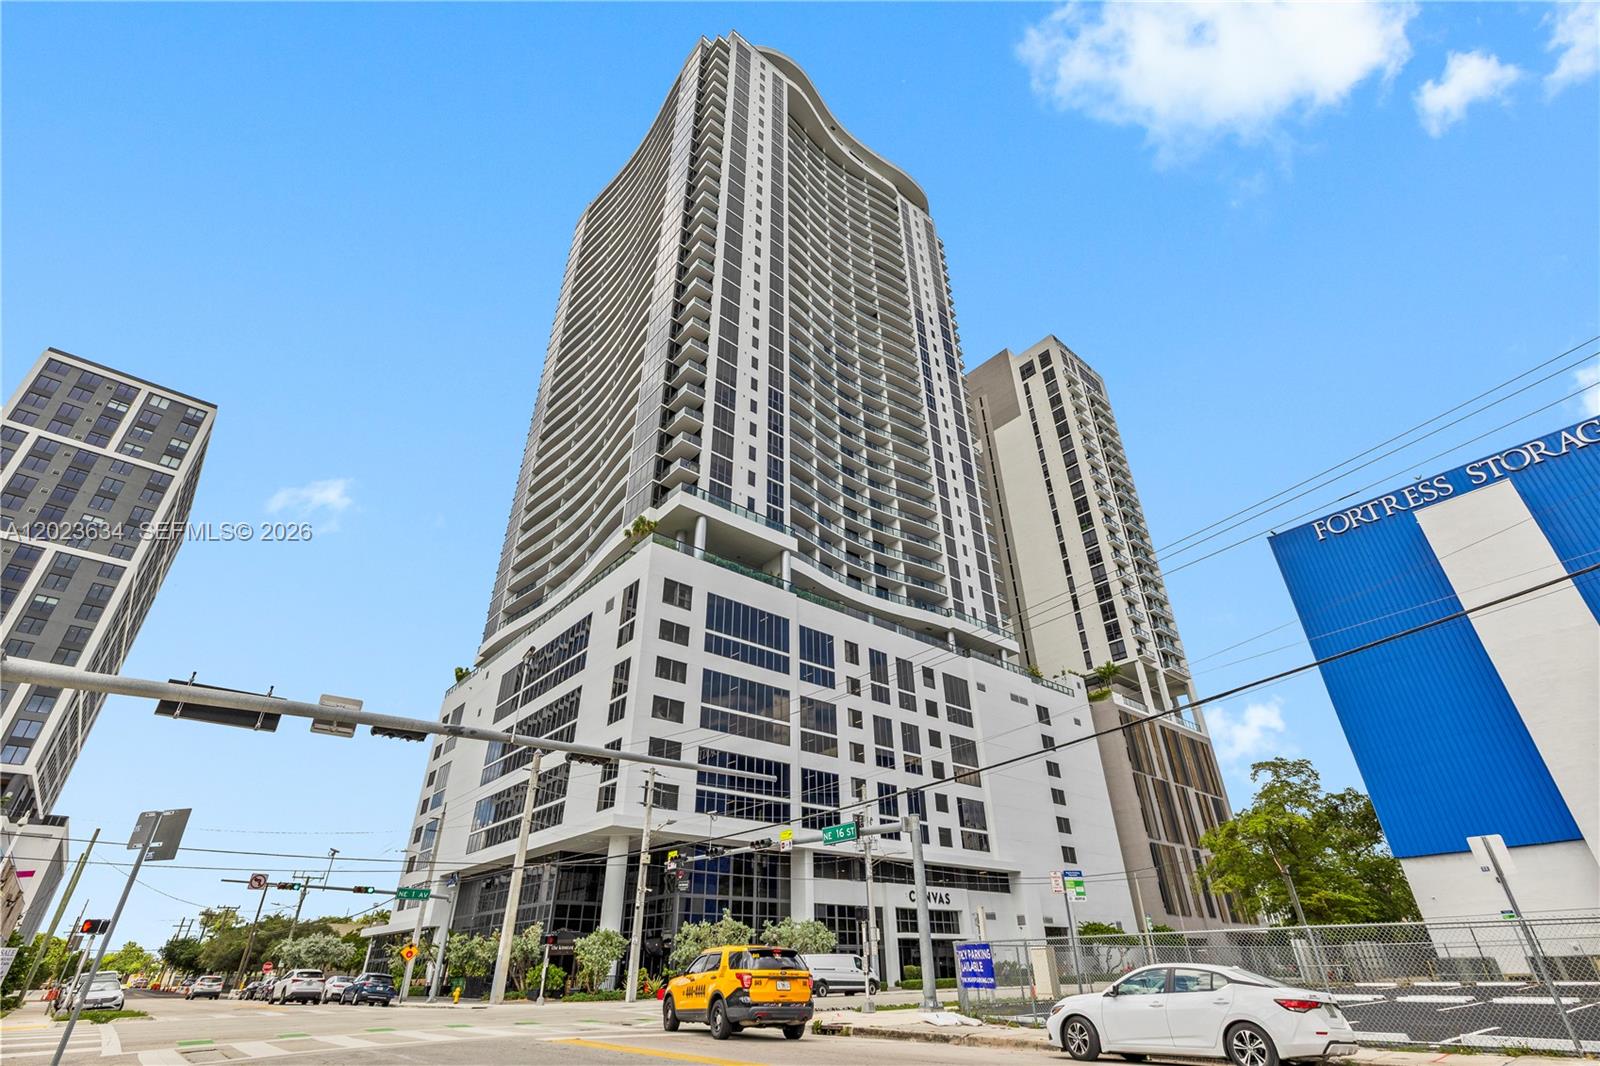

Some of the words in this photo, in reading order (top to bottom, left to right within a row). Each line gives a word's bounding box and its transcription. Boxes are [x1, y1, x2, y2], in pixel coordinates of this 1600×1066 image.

[1312, 475, 1454, 541] FORTRESS
[823, 831, 833, 840] NE
[836, 828, 845, 838] 16
[846, 827, 855, 836] ST
[909, 890, 951, 905] CNVAS
[968, 949, 991, 960] PARKING
